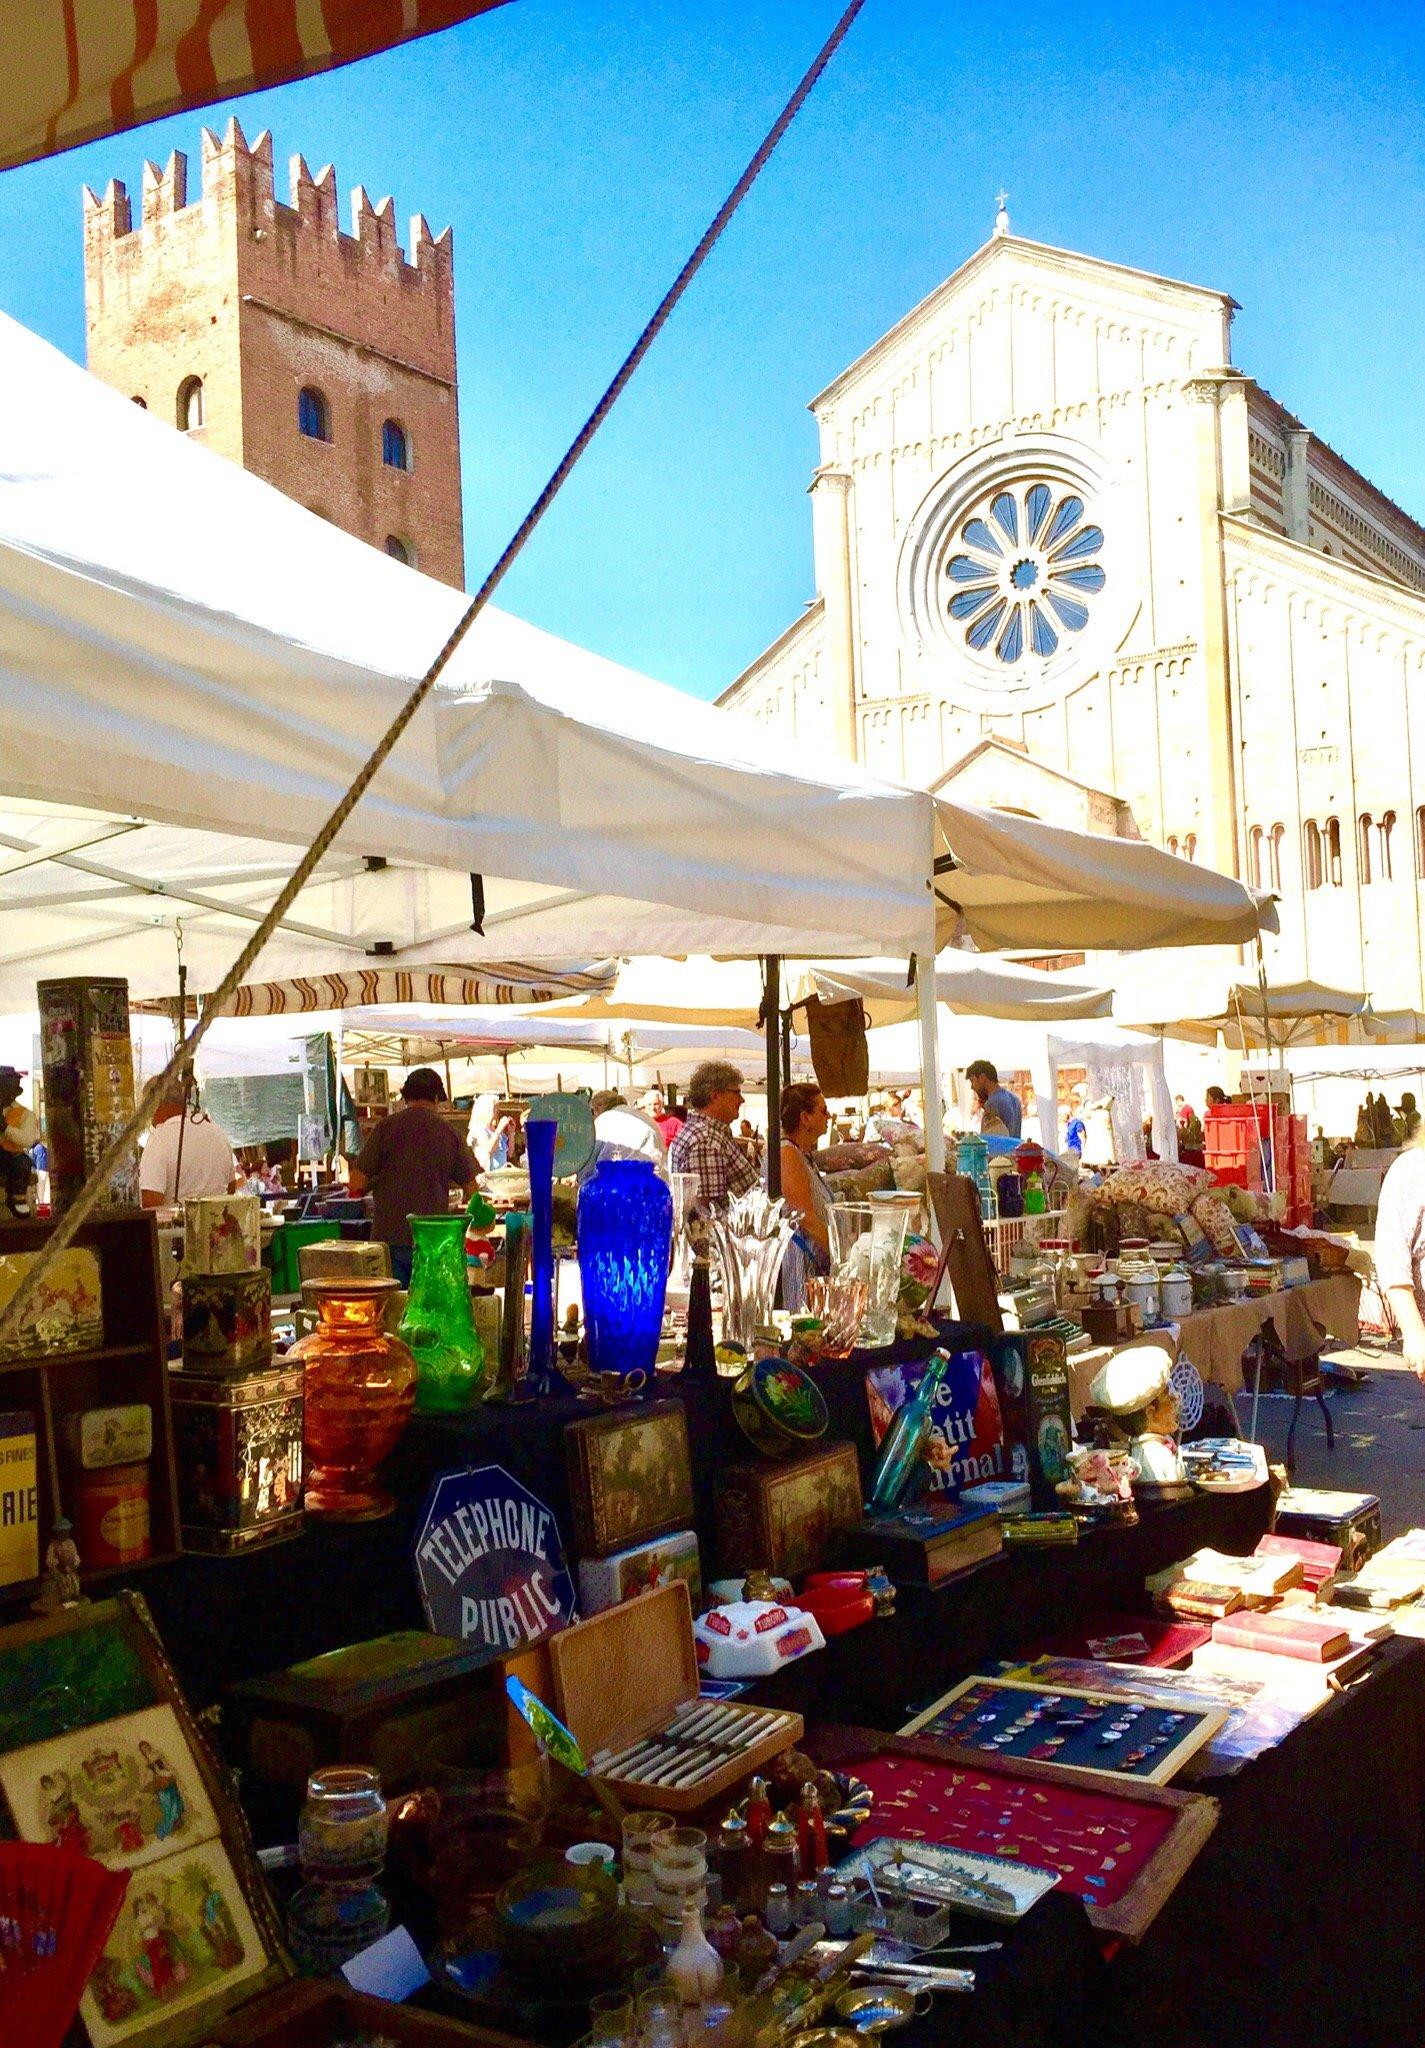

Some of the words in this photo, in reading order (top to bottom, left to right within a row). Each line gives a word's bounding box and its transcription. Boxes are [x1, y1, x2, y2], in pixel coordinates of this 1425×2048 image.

[930, 1408, 977, 1444] etit
[928, 1443, 1004, 1492] urnal
[420, 1498, 550, 1586] TÉLÉPHONE
[461, 1569, 561, 1649] PUBLIC
